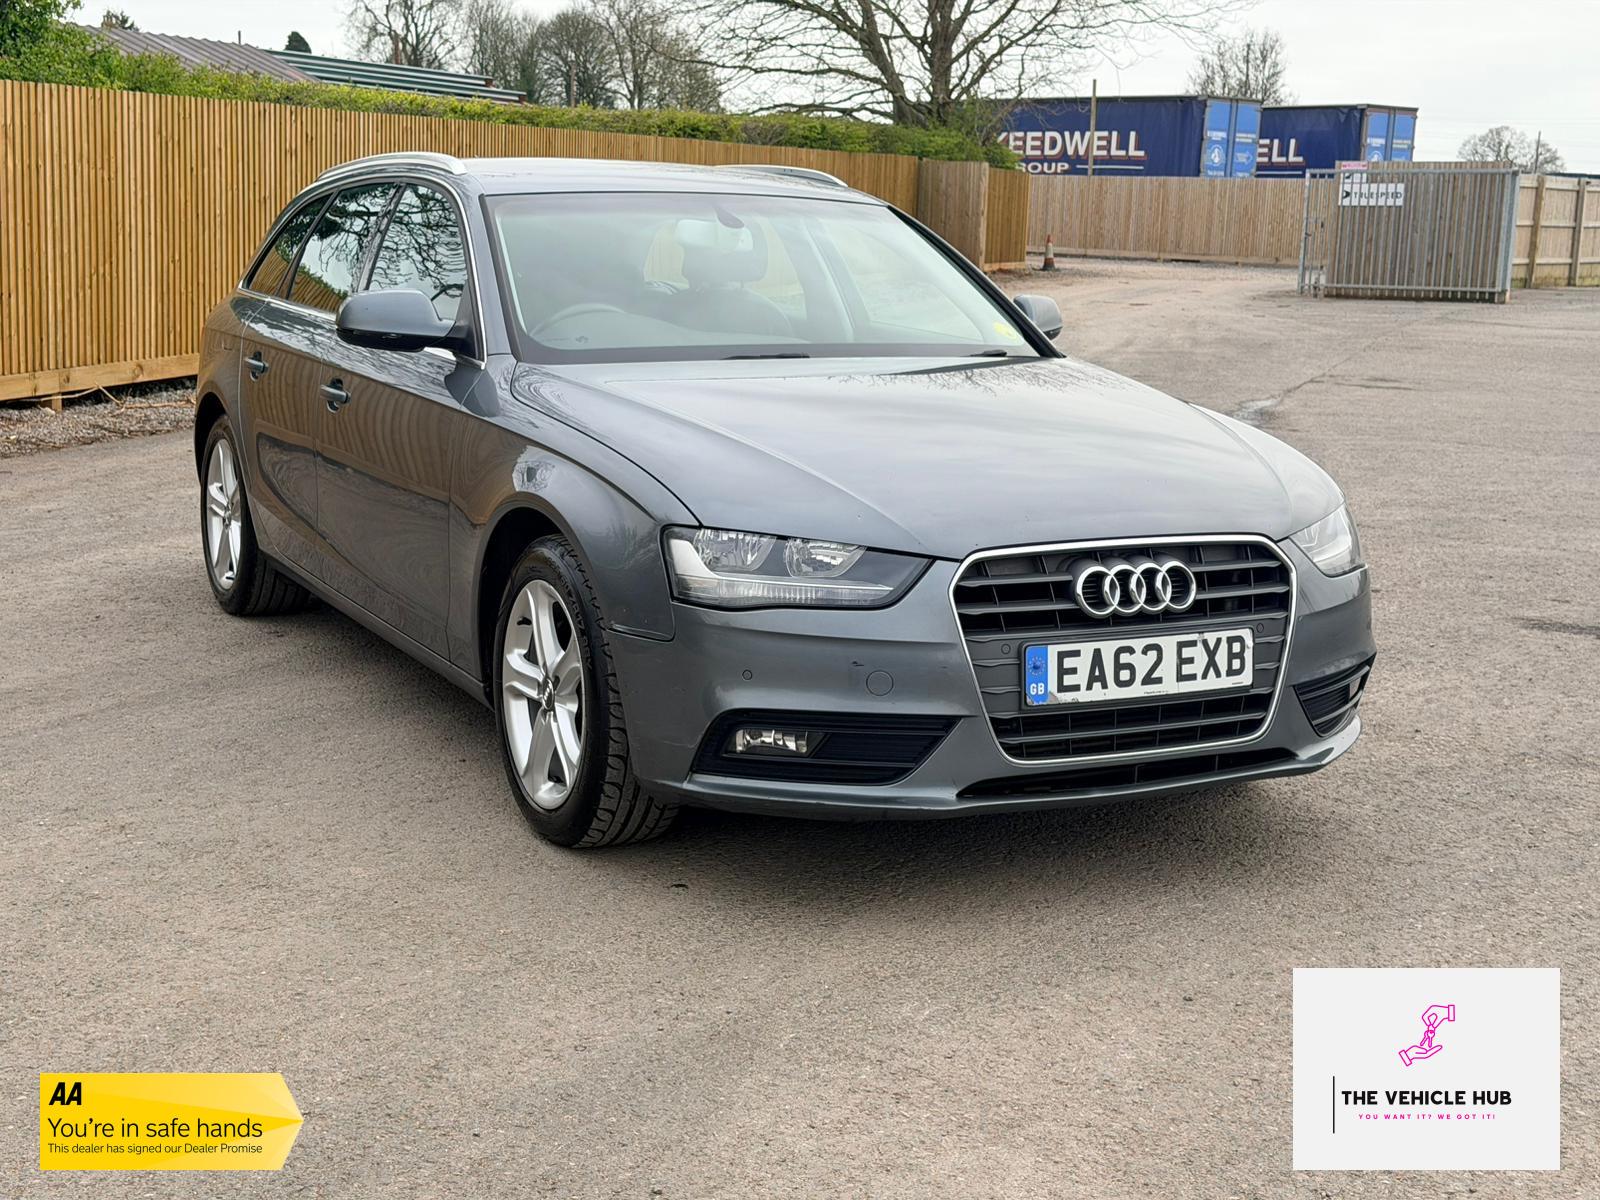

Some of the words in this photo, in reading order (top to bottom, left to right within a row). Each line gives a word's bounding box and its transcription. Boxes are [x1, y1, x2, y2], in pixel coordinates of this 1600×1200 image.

[1015, 161, 1070, 174] ROUP
[1056, 642, 1164, 694] EA62
[1176, 635, 1246, 683] EXB
[1029, 682, 1045, 696] GB
